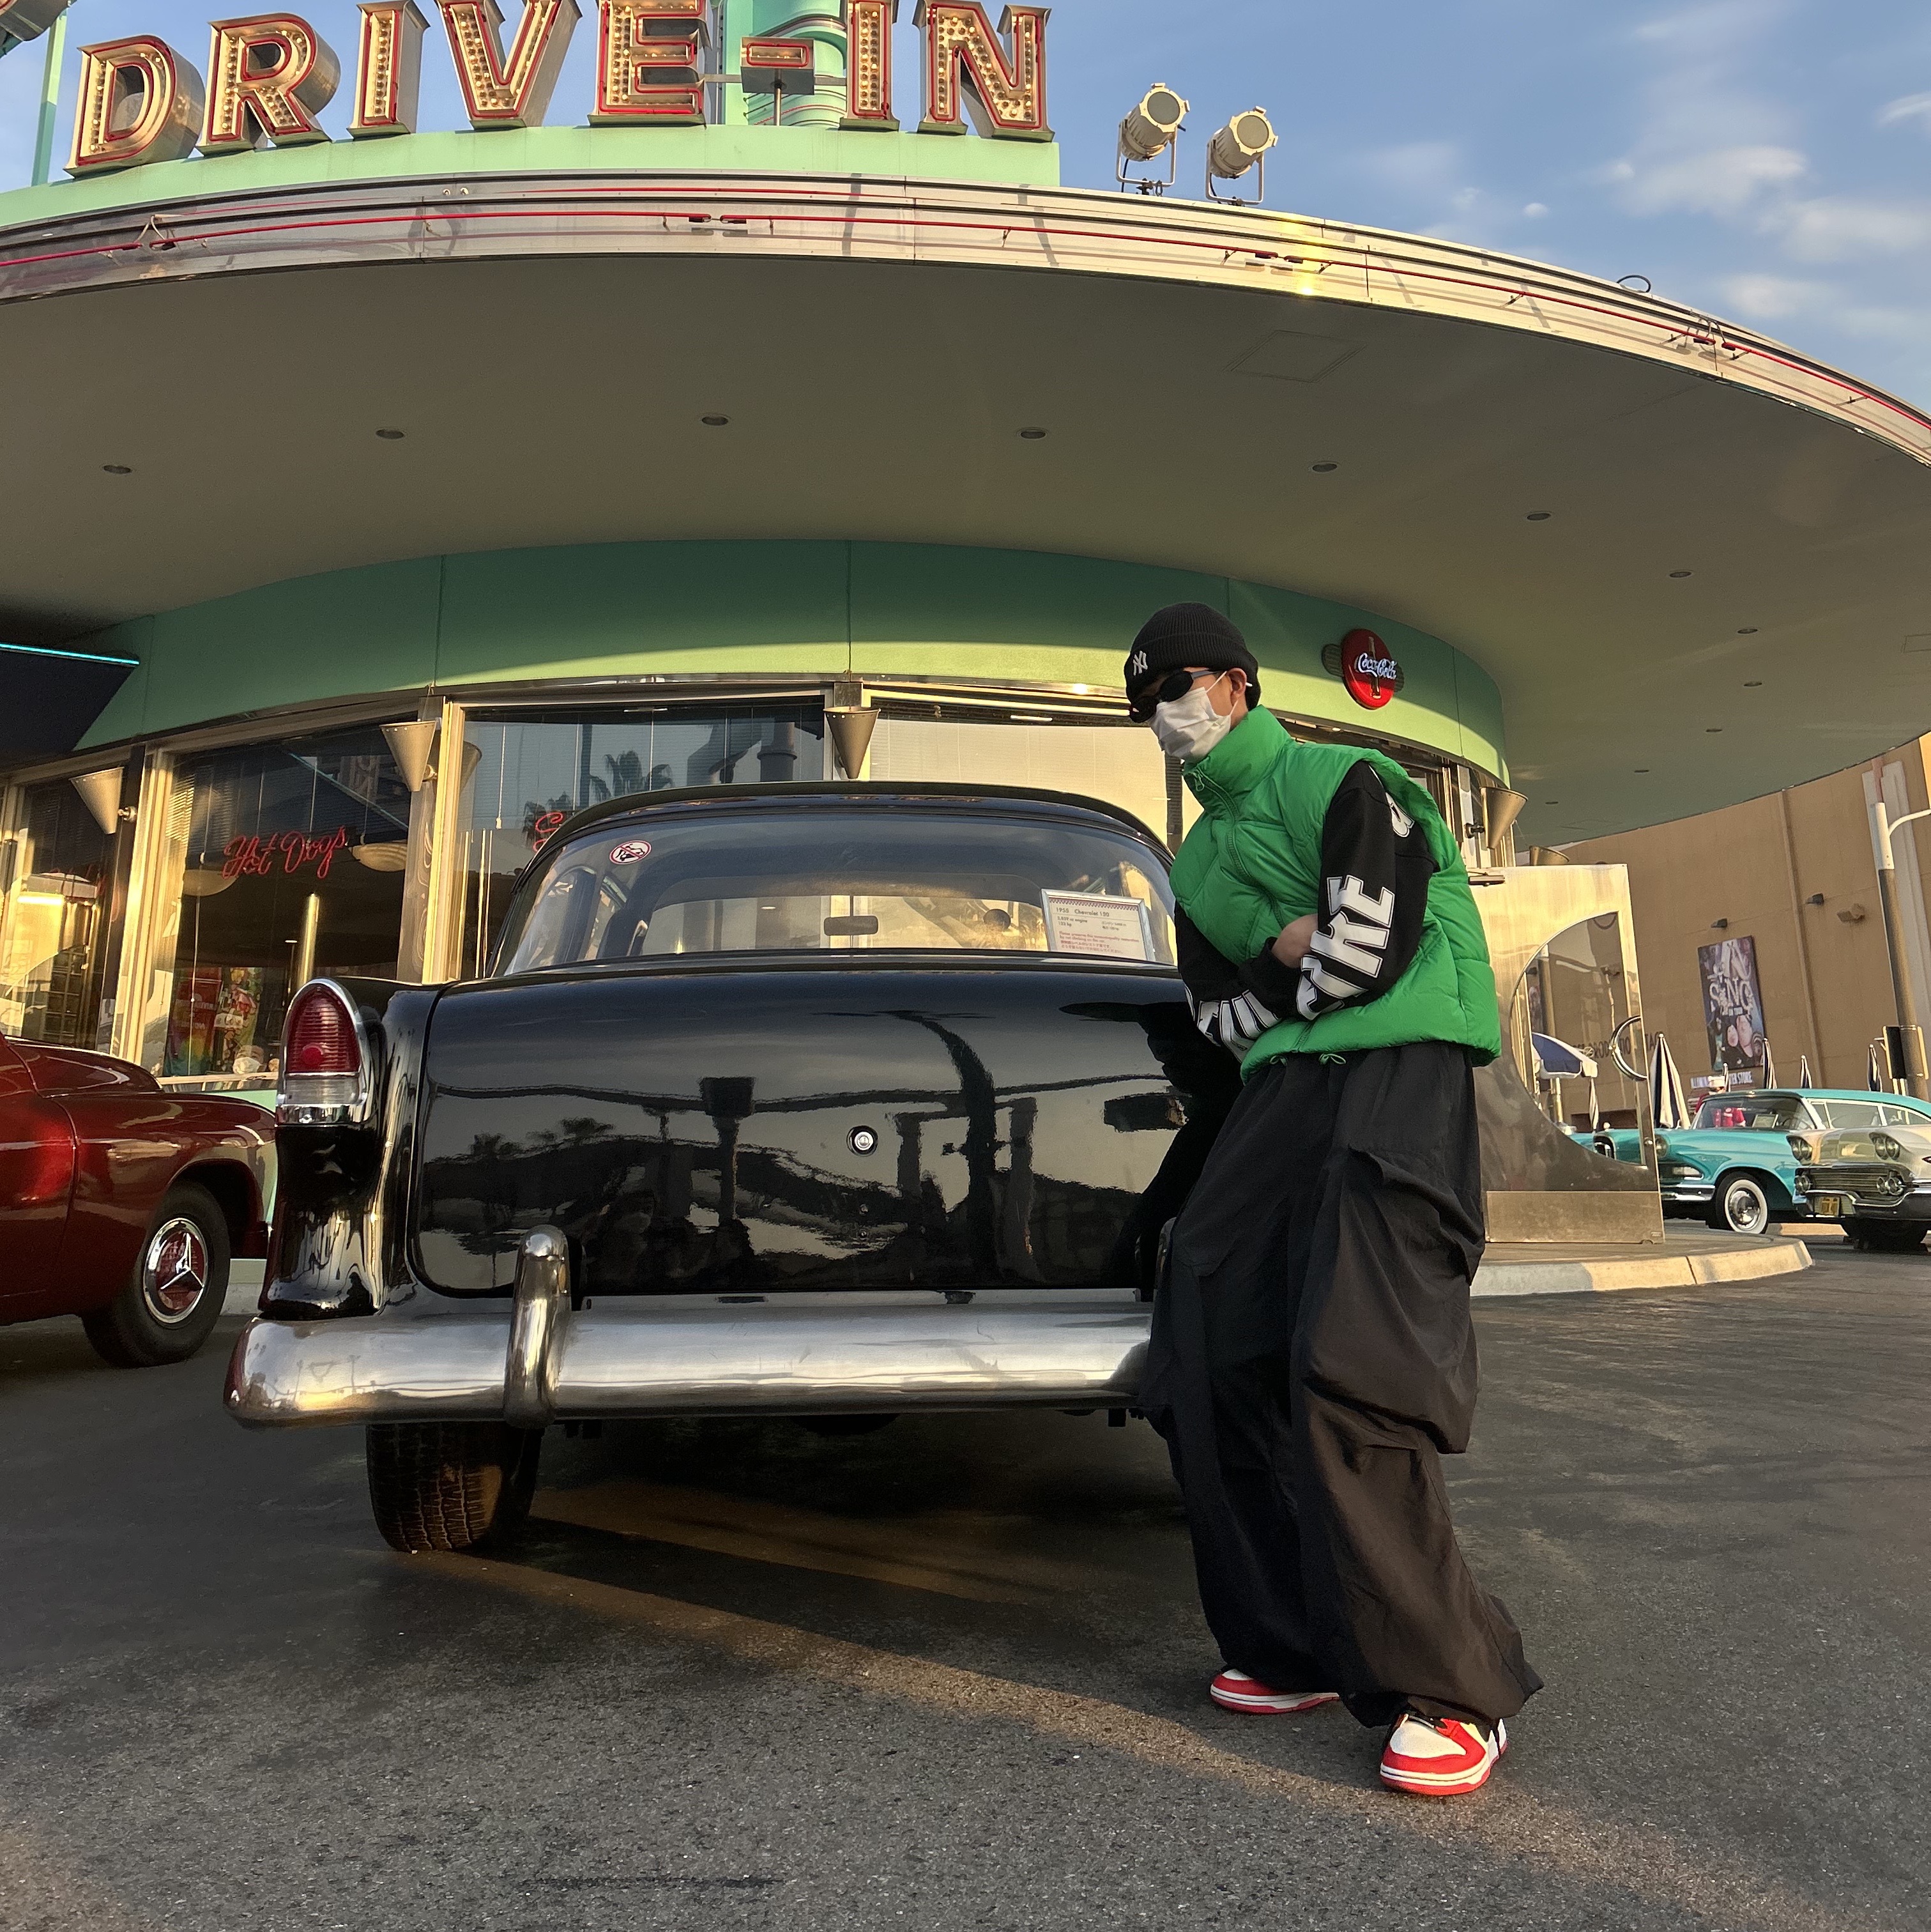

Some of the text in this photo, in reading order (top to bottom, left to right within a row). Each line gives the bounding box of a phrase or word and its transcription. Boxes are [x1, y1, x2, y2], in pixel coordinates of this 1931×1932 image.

[1132, 650, 1149, 677] NY
[1357, 652, 1398, 680] Coca-Cola
[221, 825, 346, 880] Hot Dogs
